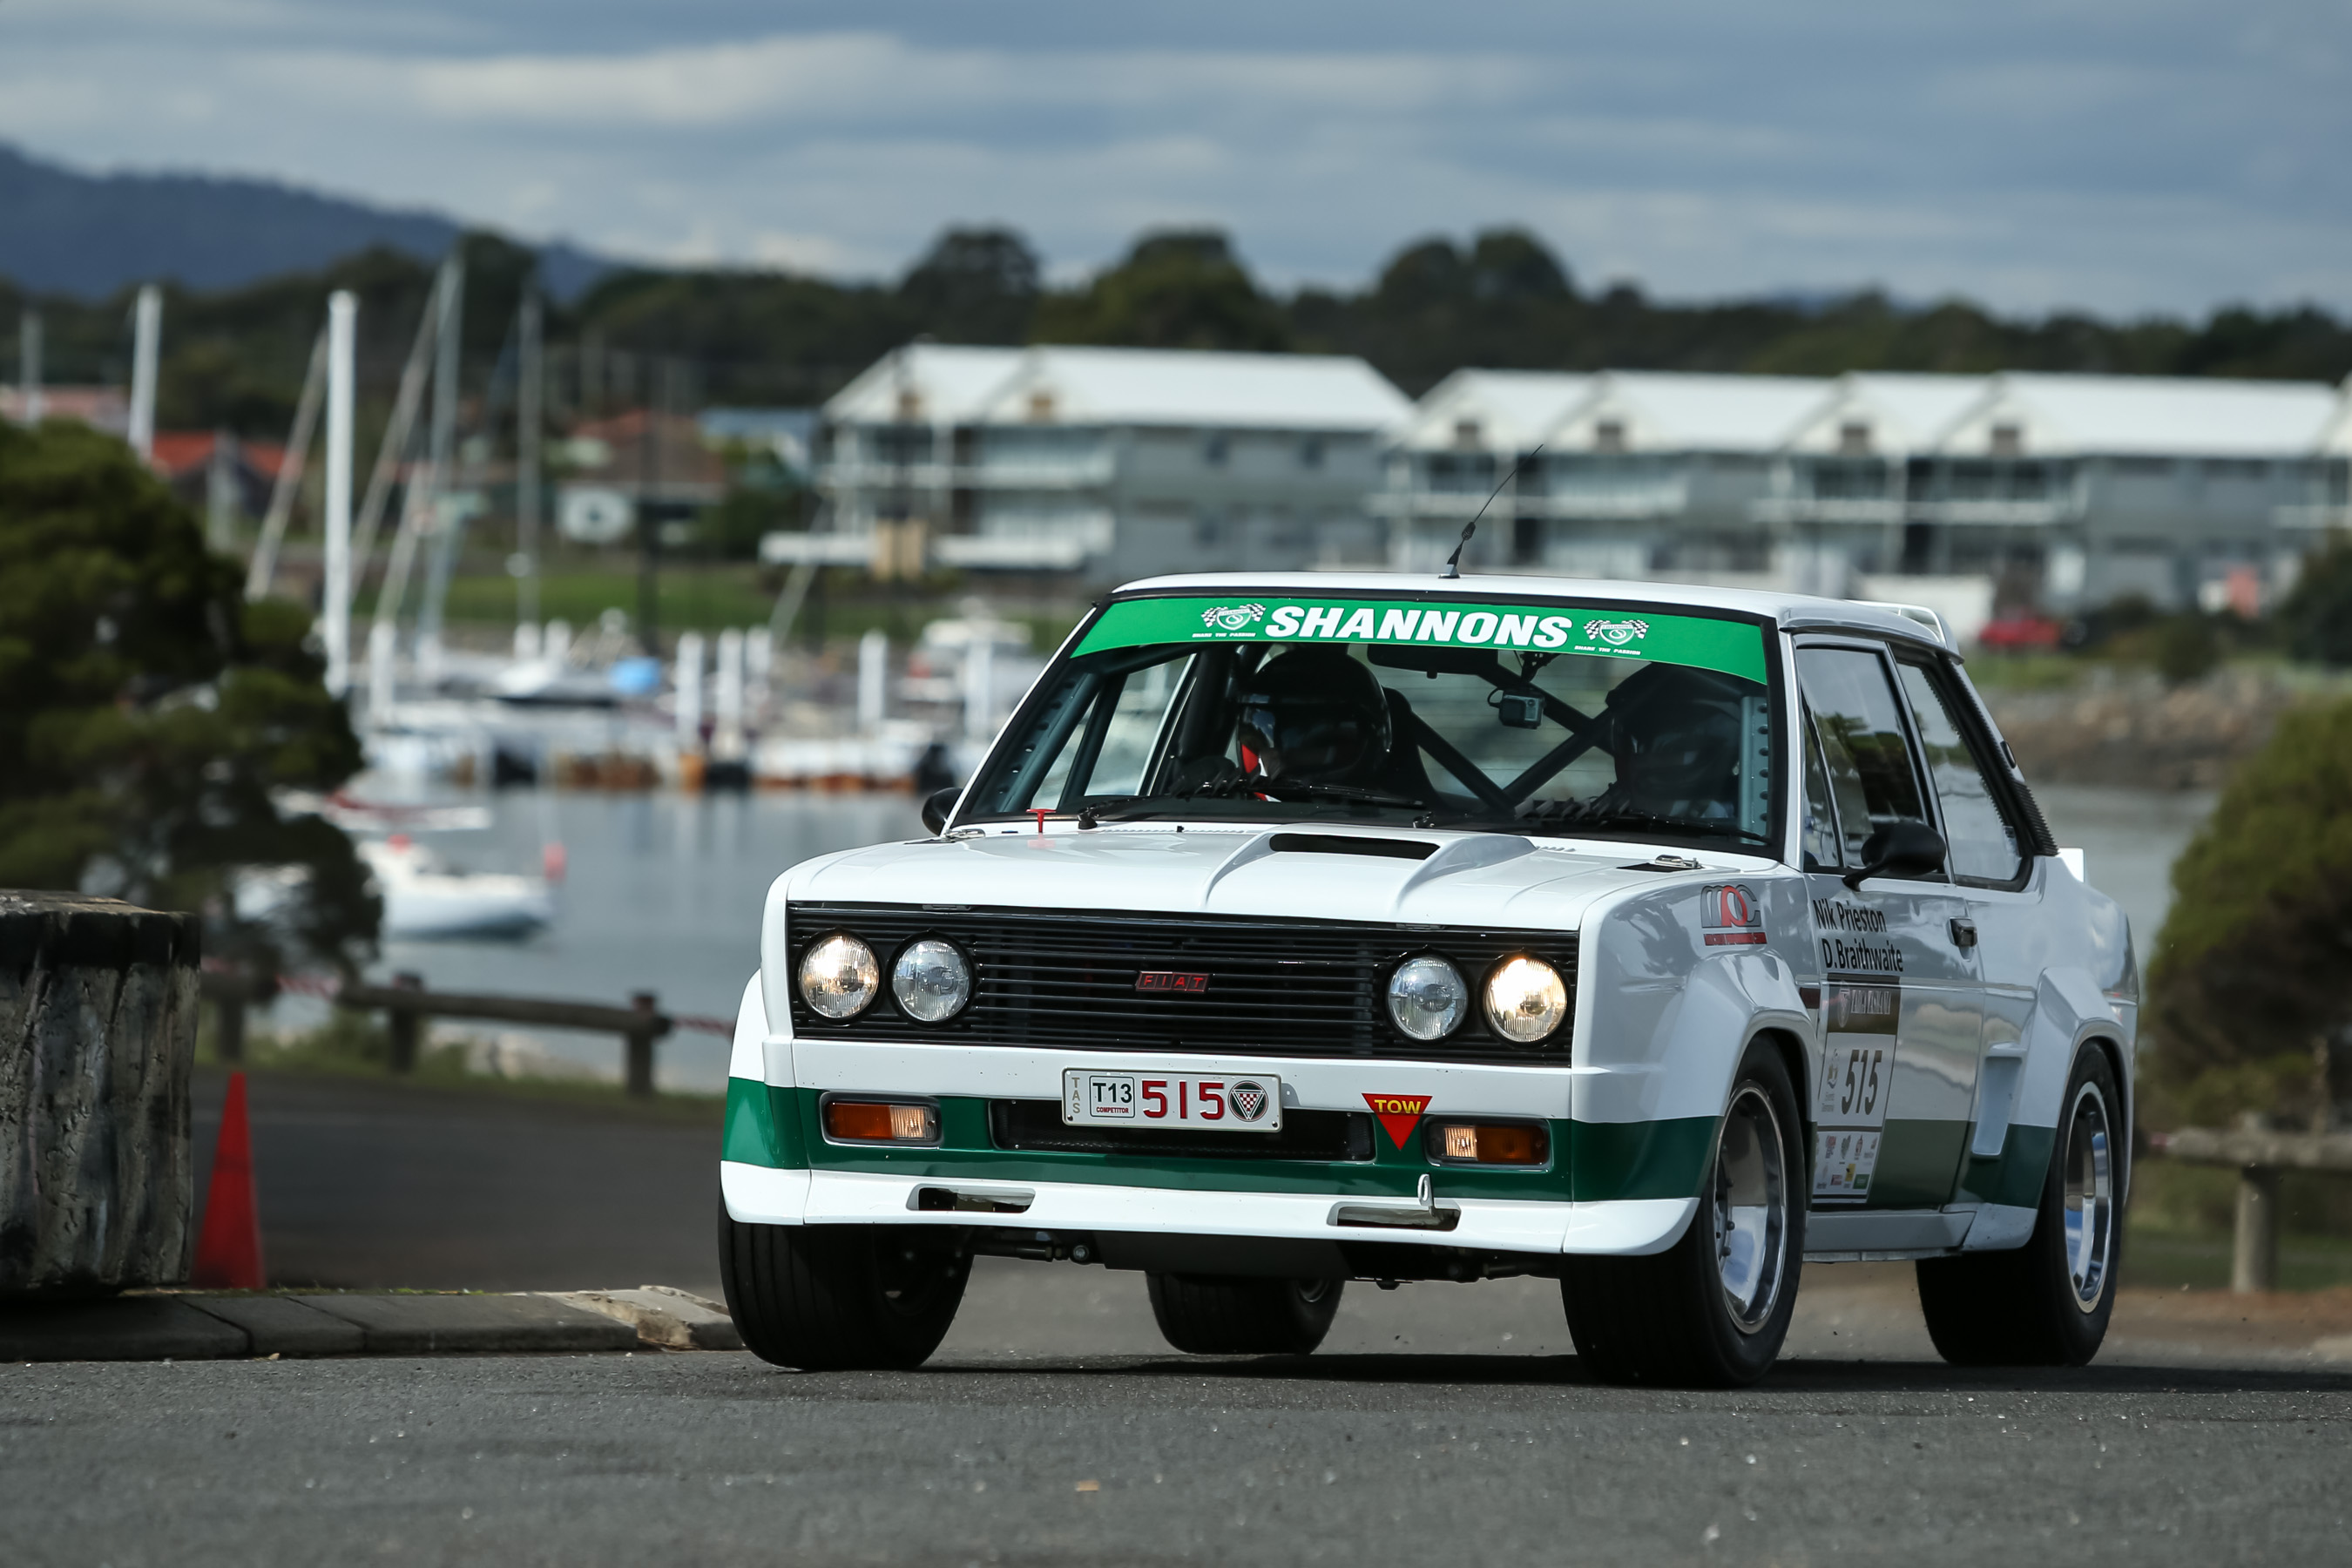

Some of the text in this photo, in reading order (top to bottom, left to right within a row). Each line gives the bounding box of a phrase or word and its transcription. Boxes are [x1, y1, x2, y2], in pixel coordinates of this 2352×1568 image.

[1265, 605, 1572, 648] SHANNONS
[1813, 898, 1887, 932] Nik Prieston
[1144, 976, 1204, 988] FIAT
[1071, 1077, 1081, 1113] TAS
[1092, 1083, 1132, 1103] T13
[1141, 1079, 1224, 1120] 515
[1842, 1049, 1882, 1115] 515
[1374, 1099, 1421, 1114] TOW
